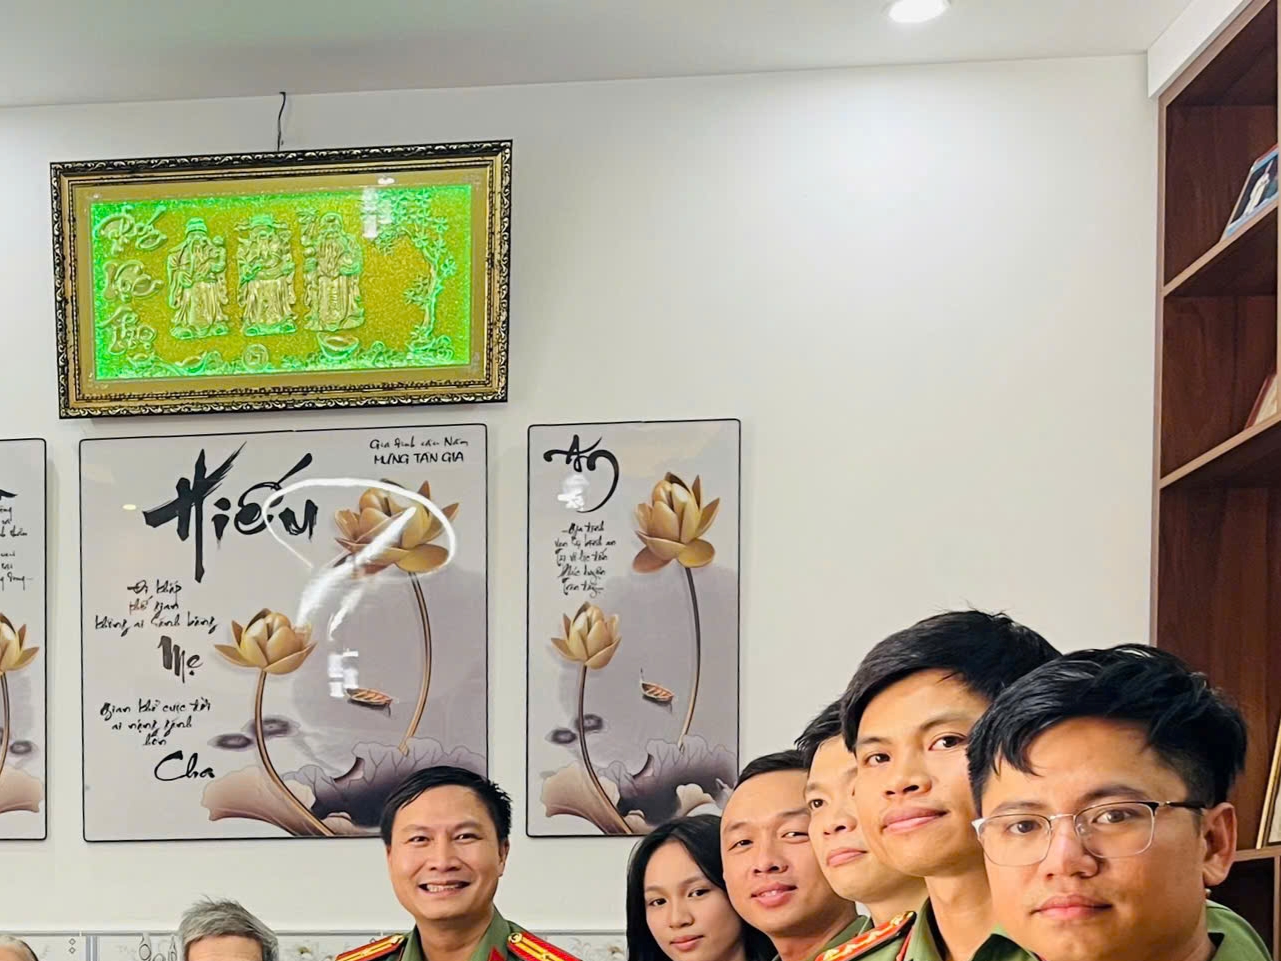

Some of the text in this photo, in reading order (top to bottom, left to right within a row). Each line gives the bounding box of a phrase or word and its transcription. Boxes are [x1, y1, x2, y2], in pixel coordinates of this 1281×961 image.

[369, 439, 390, 450] Gia
[441, 451, 464, 463] GIA
[143, 440, 318, 584] Hiếu
[133, 619, 144, 628] ai
[157, 634, 204, 685] Mẹ
[111, 720, 122, 730] ai
[154, 750, 215, 782] Cha
